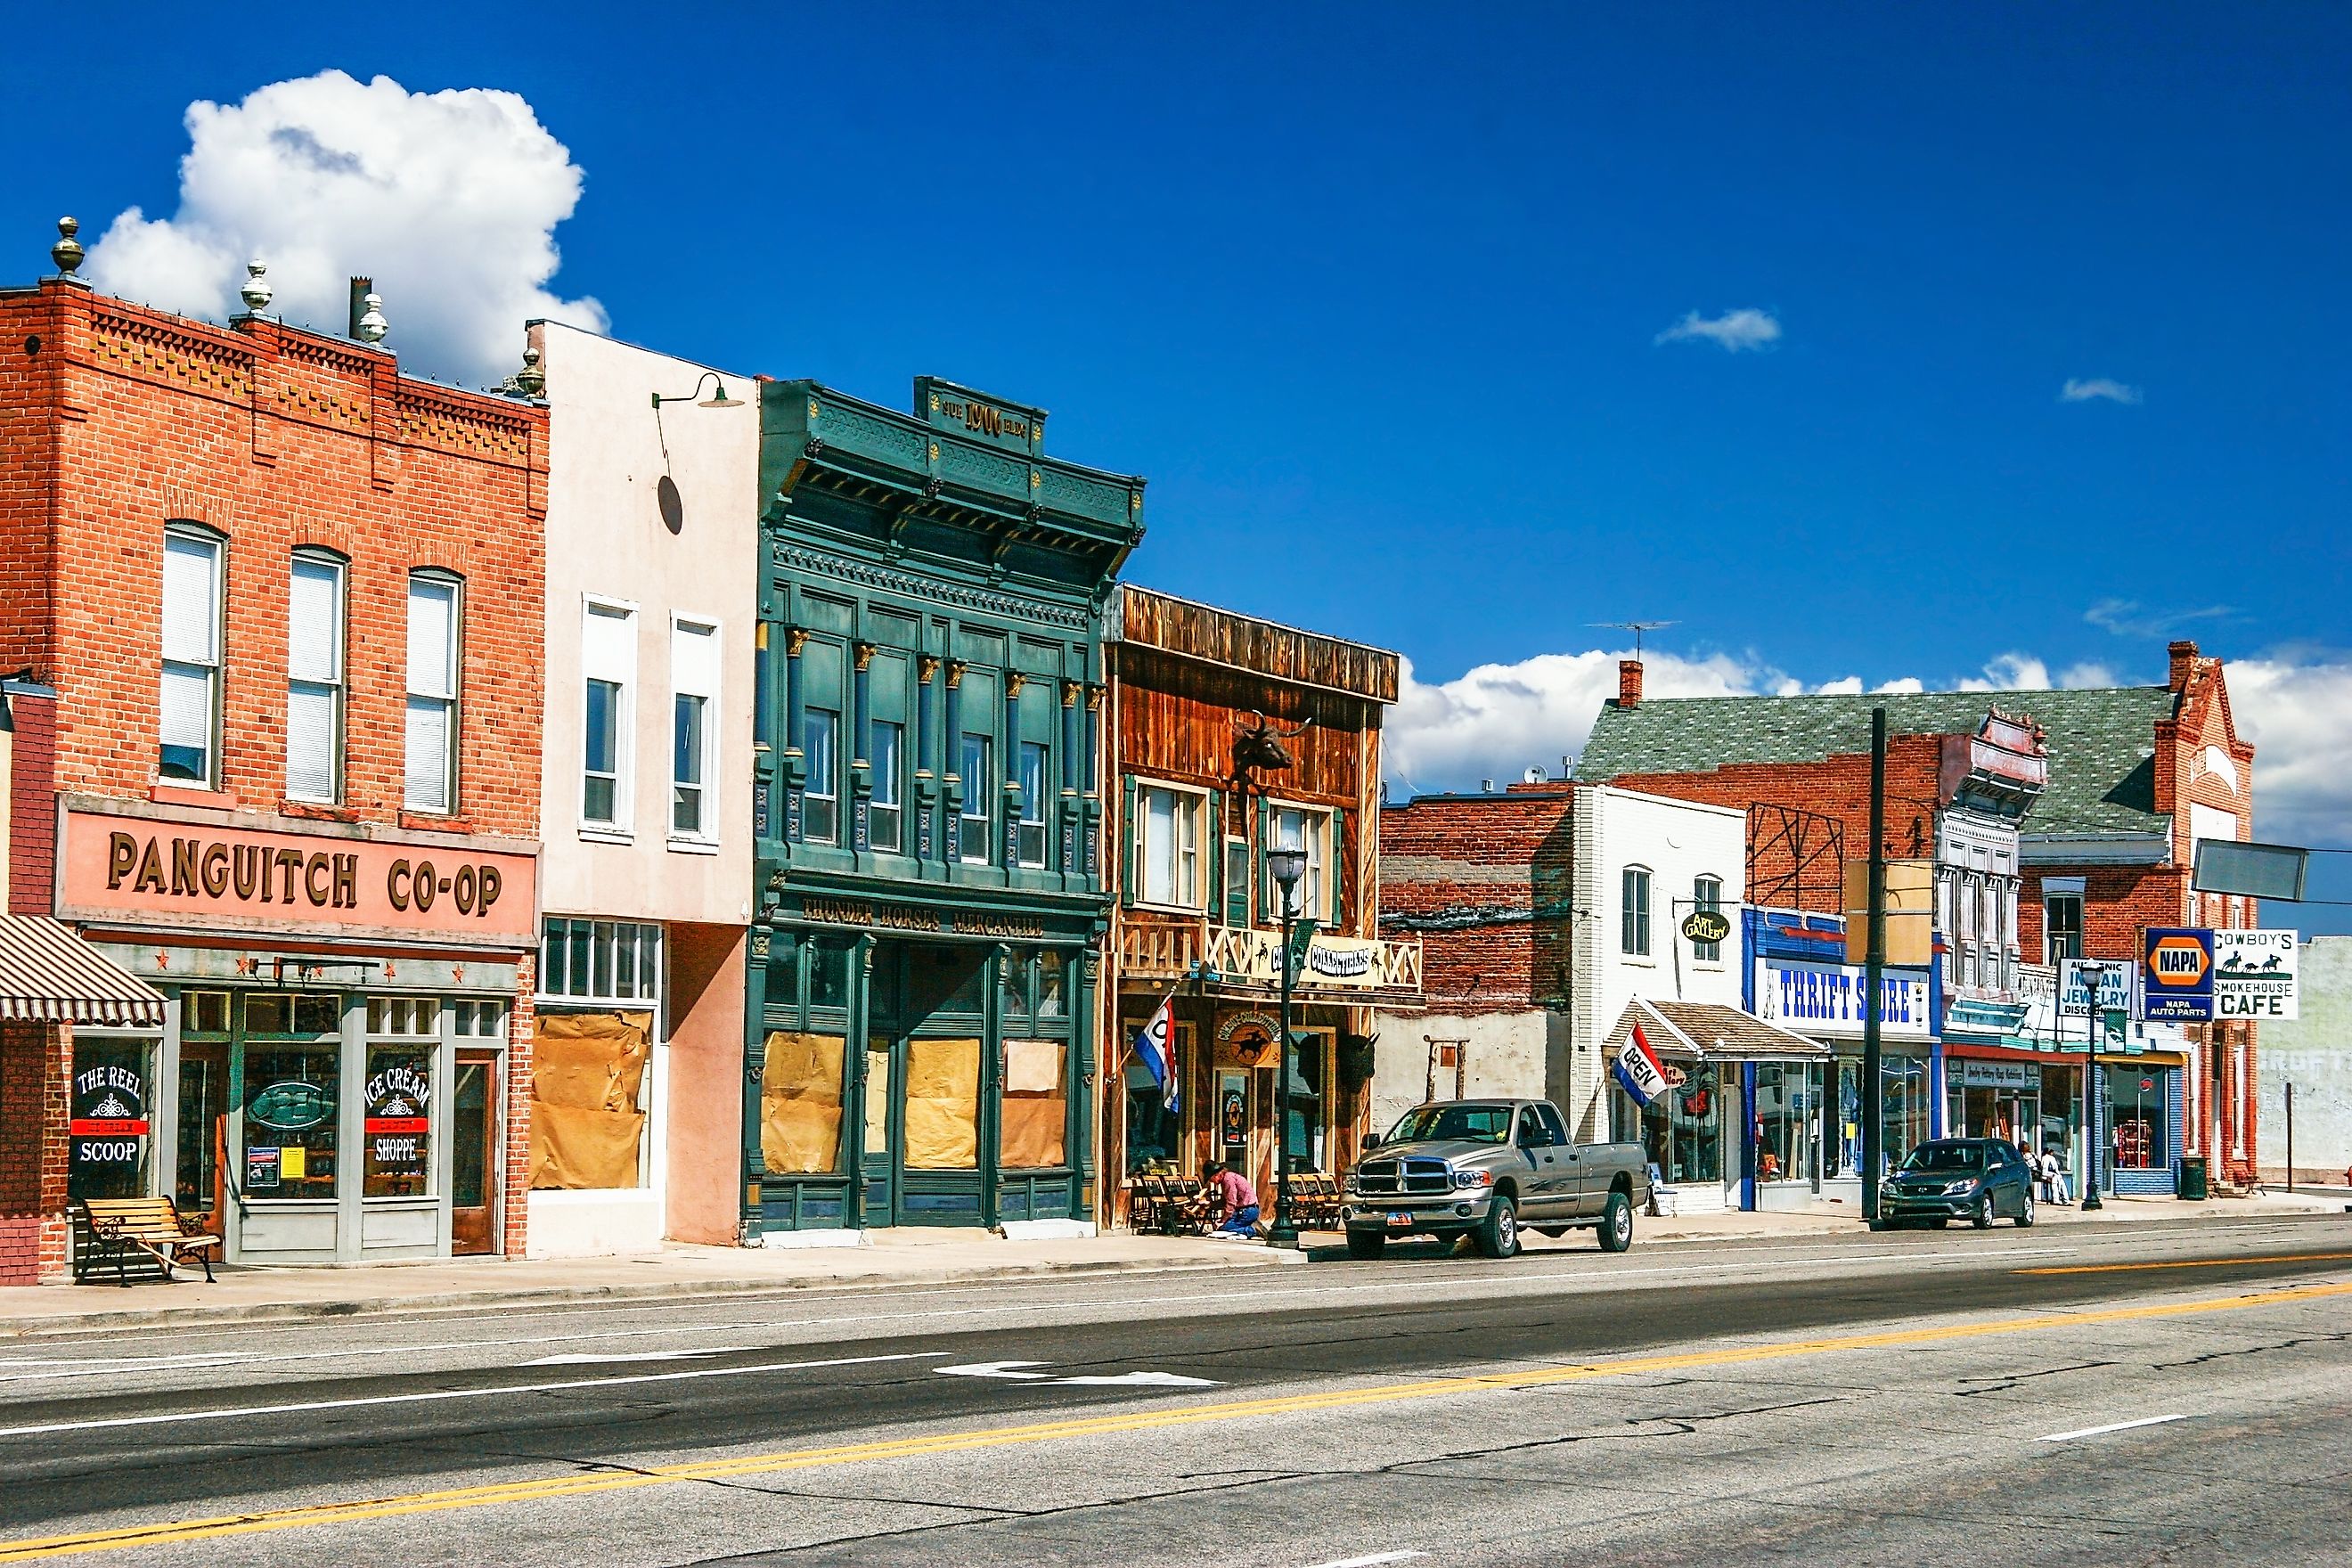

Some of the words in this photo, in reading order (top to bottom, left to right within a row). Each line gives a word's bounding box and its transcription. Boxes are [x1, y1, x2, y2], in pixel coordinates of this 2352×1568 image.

[966, 403, 1001, 437] 1906
[107, 831, 358, 909] PANGUITCH
[388, 859, 502, 918] CO-OP
[1686, 923, 1727, 939] GALLERY
[1694, 914, 1713, 928] ART
[2215, 934, 2292, 950] COWBOY'S
[1311, 944, 1369, 978] COLLECTIBLES
[2160, 951, 2198, 973] NAPA
[2070, 971, 2122, 989] INAN
[2214, 983, 2293, 997] SMOKEHOUSE
[1780, 969, 1850, 1020] THRIFT
[1856, 976, 1910, 1024] SORE
[2221, 994, 2283, 1016] CAFE
[2150, 1007, 2175, 1016] AUTO
[2176, 1009, 2207, 1017] PARTS
[1623, 1047, 1657, 1087] OPEN
[78, 1067, 106, 1095] THE
[109, 1066, 141, 1100] REEL
[363, 1073, 387, 1108] ICE
[387, 1068, 430, 1108] CREAM
[79, 1141, 137, 1161] SCOOP
[375, 1138, 416, 1161] SHOPPE
